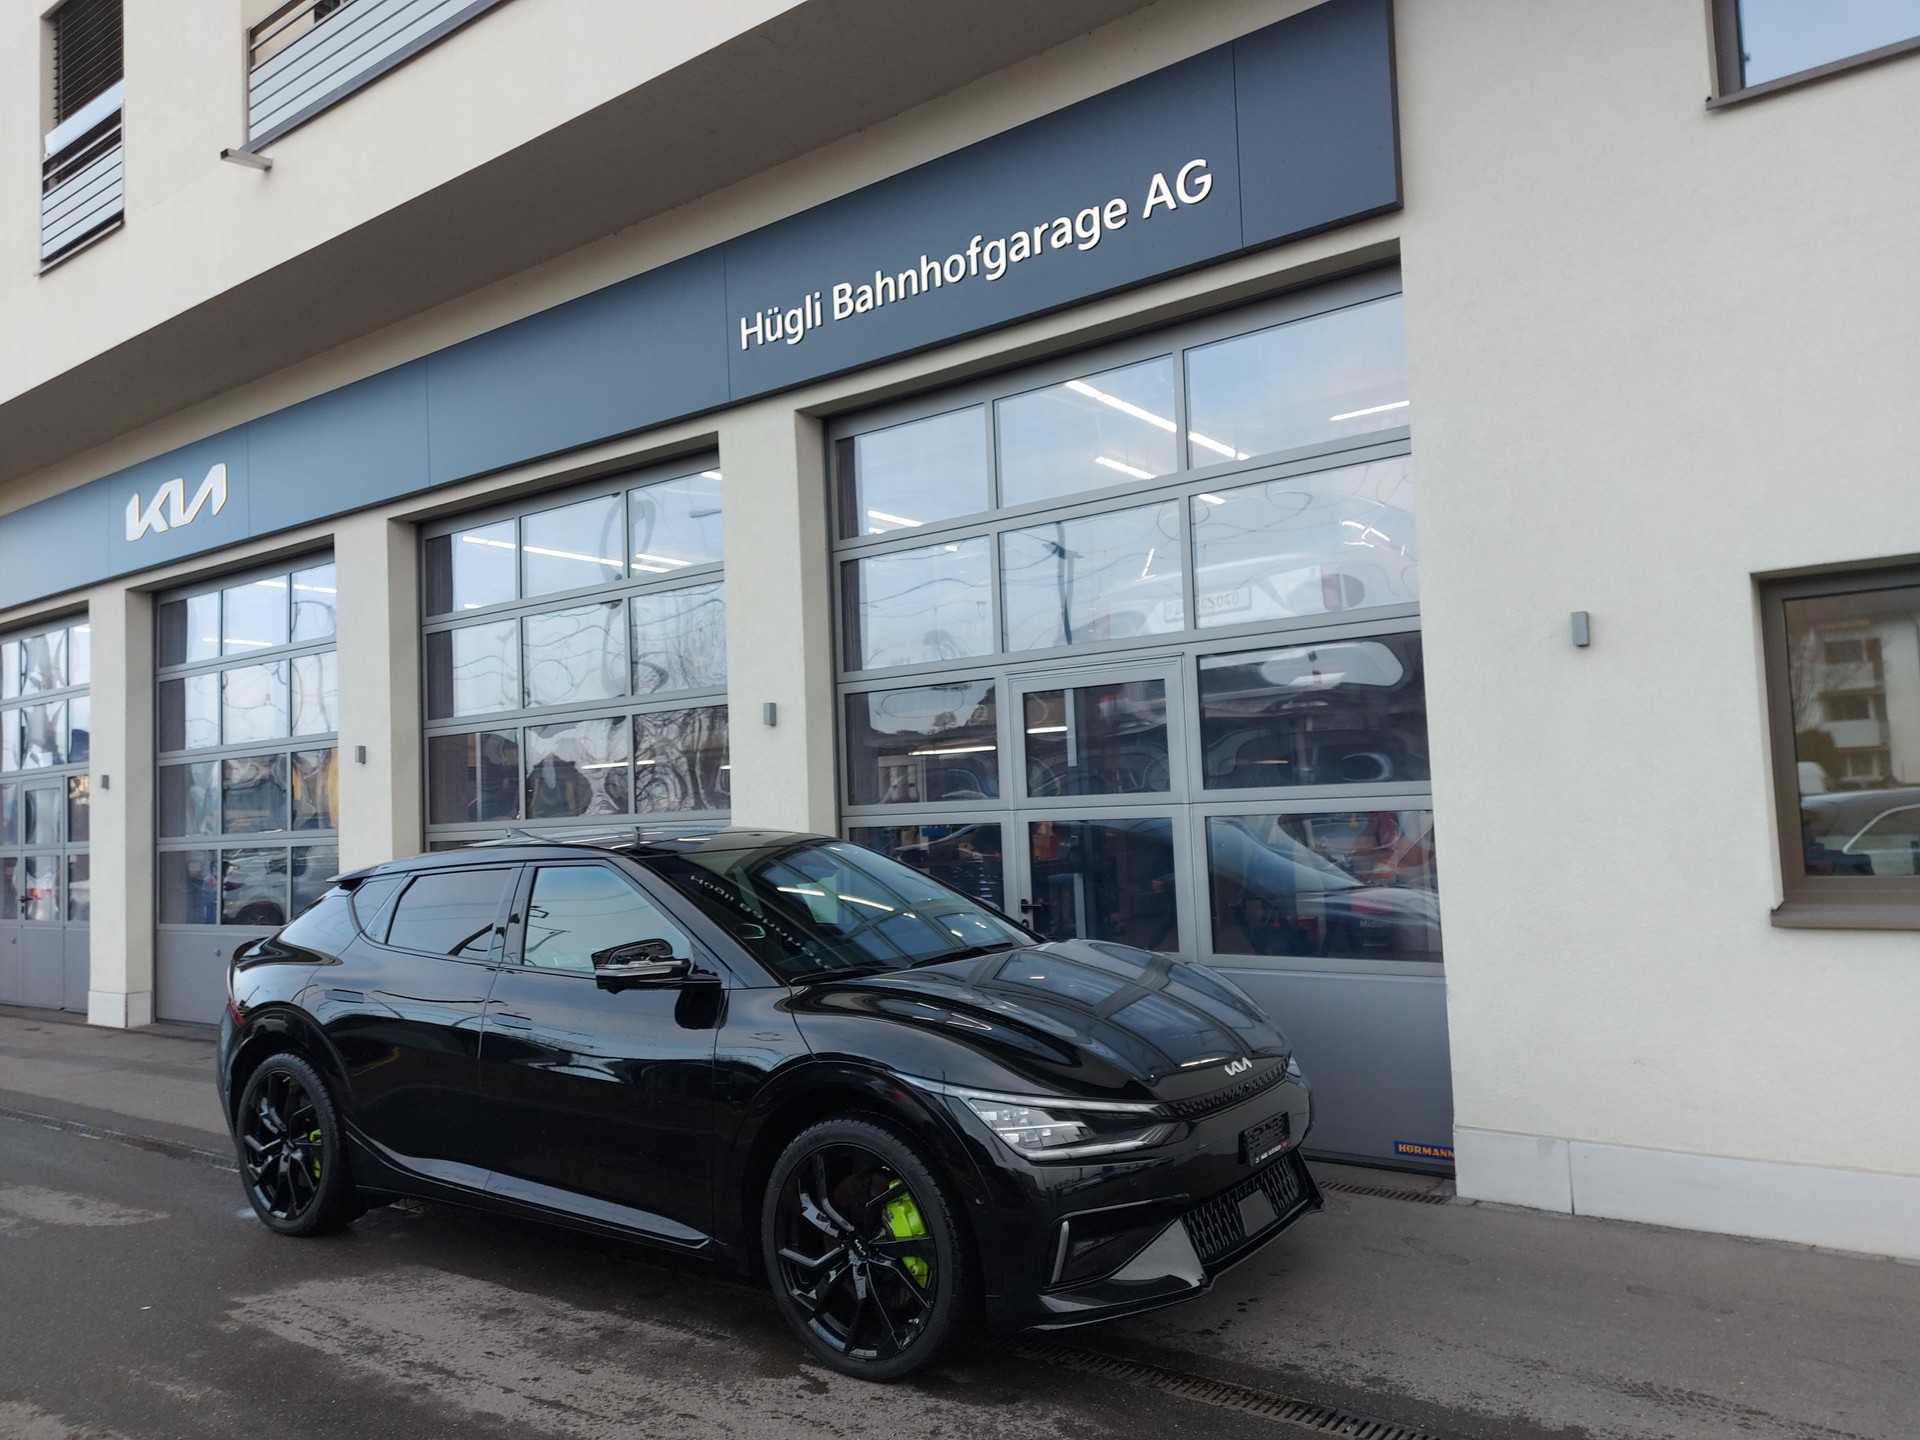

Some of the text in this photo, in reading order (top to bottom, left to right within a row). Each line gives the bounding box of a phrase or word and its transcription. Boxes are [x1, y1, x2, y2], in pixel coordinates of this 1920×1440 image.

[740, 158, 1213, 350] Hügli Bahnhofgarage AG
[125, 463, 228, 542] KIA
[1223, 1056, 1253, 1076] KIA
